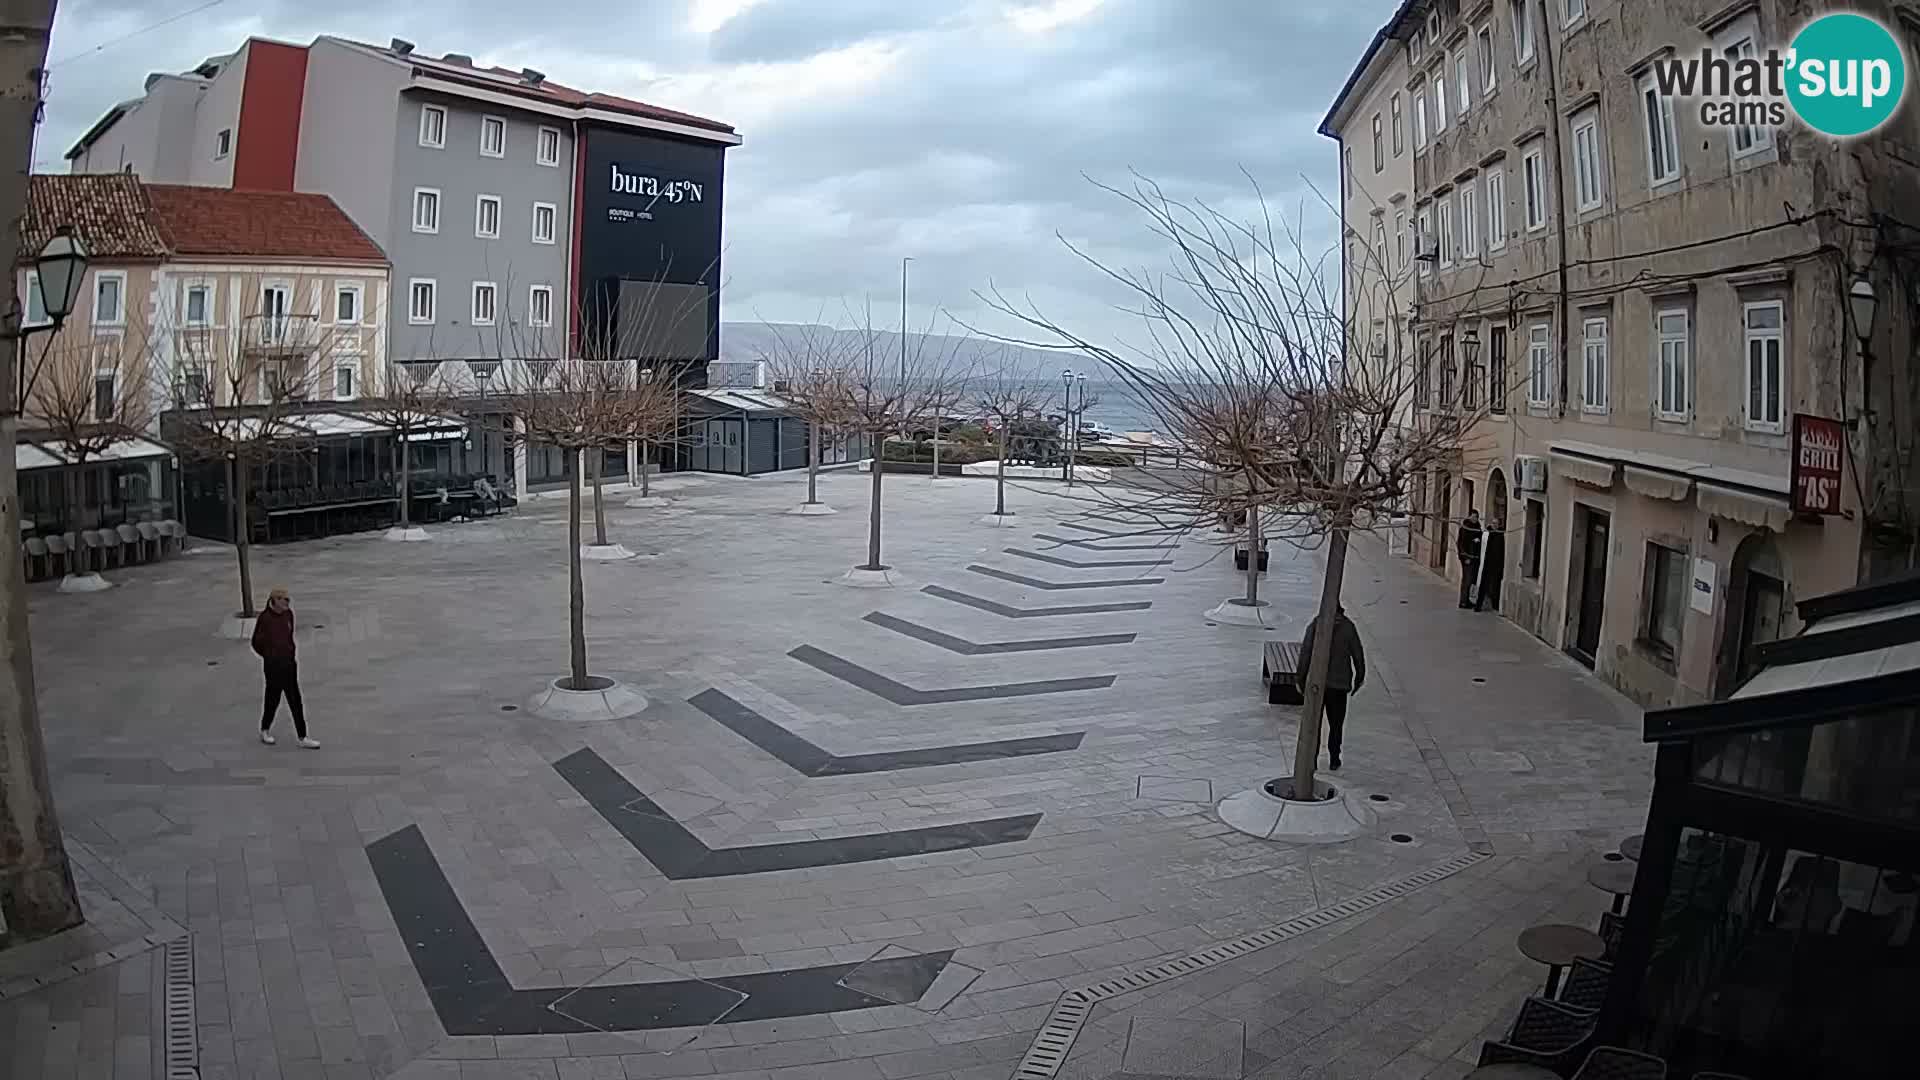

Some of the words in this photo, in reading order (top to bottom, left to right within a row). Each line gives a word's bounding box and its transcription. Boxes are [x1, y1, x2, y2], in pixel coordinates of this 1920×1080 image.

[611, 165, 658, 196] bura
[608, 208, 634, 218] BOUTIQUE
[636, 211, 653, 220] HOTEL
[1799, 447, 1840, 471] GRILL
[1798, 475, 1838, 510] "AS"
